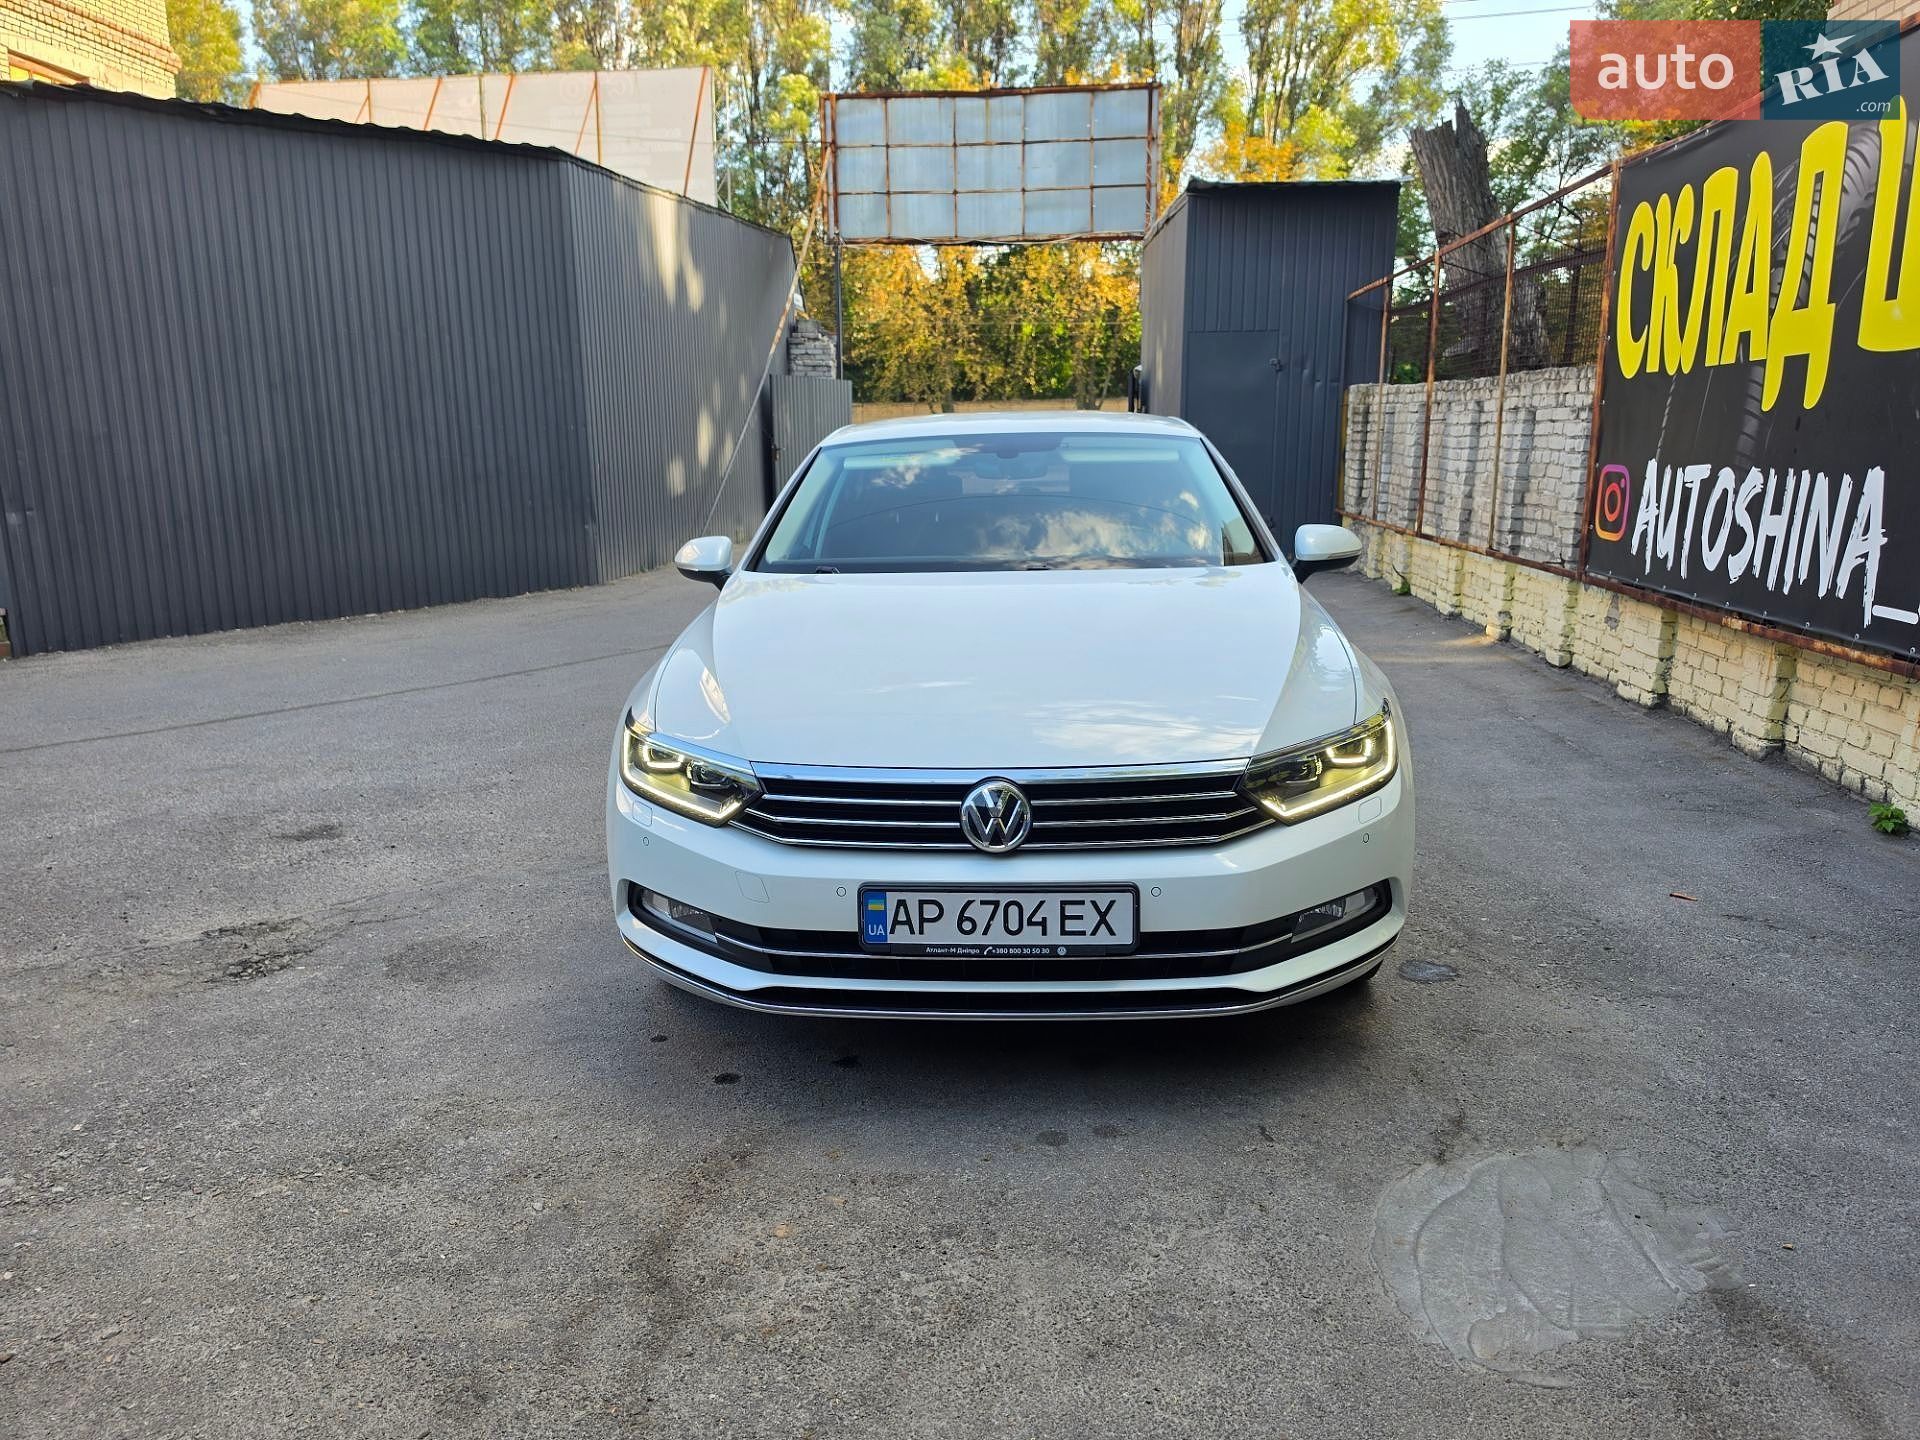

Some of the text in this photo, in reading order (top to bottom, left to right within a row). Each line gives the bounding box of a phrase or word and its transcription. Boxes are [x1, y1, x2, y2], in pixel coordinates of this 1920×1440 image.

[1616, 121, 1849, 412] СКЛАД
[1630, 458, 1920, 628] AUTOSHINA_
[868, 922, 885, 936] UA
[889, 899, 1117, 936] AP 6704 EX
